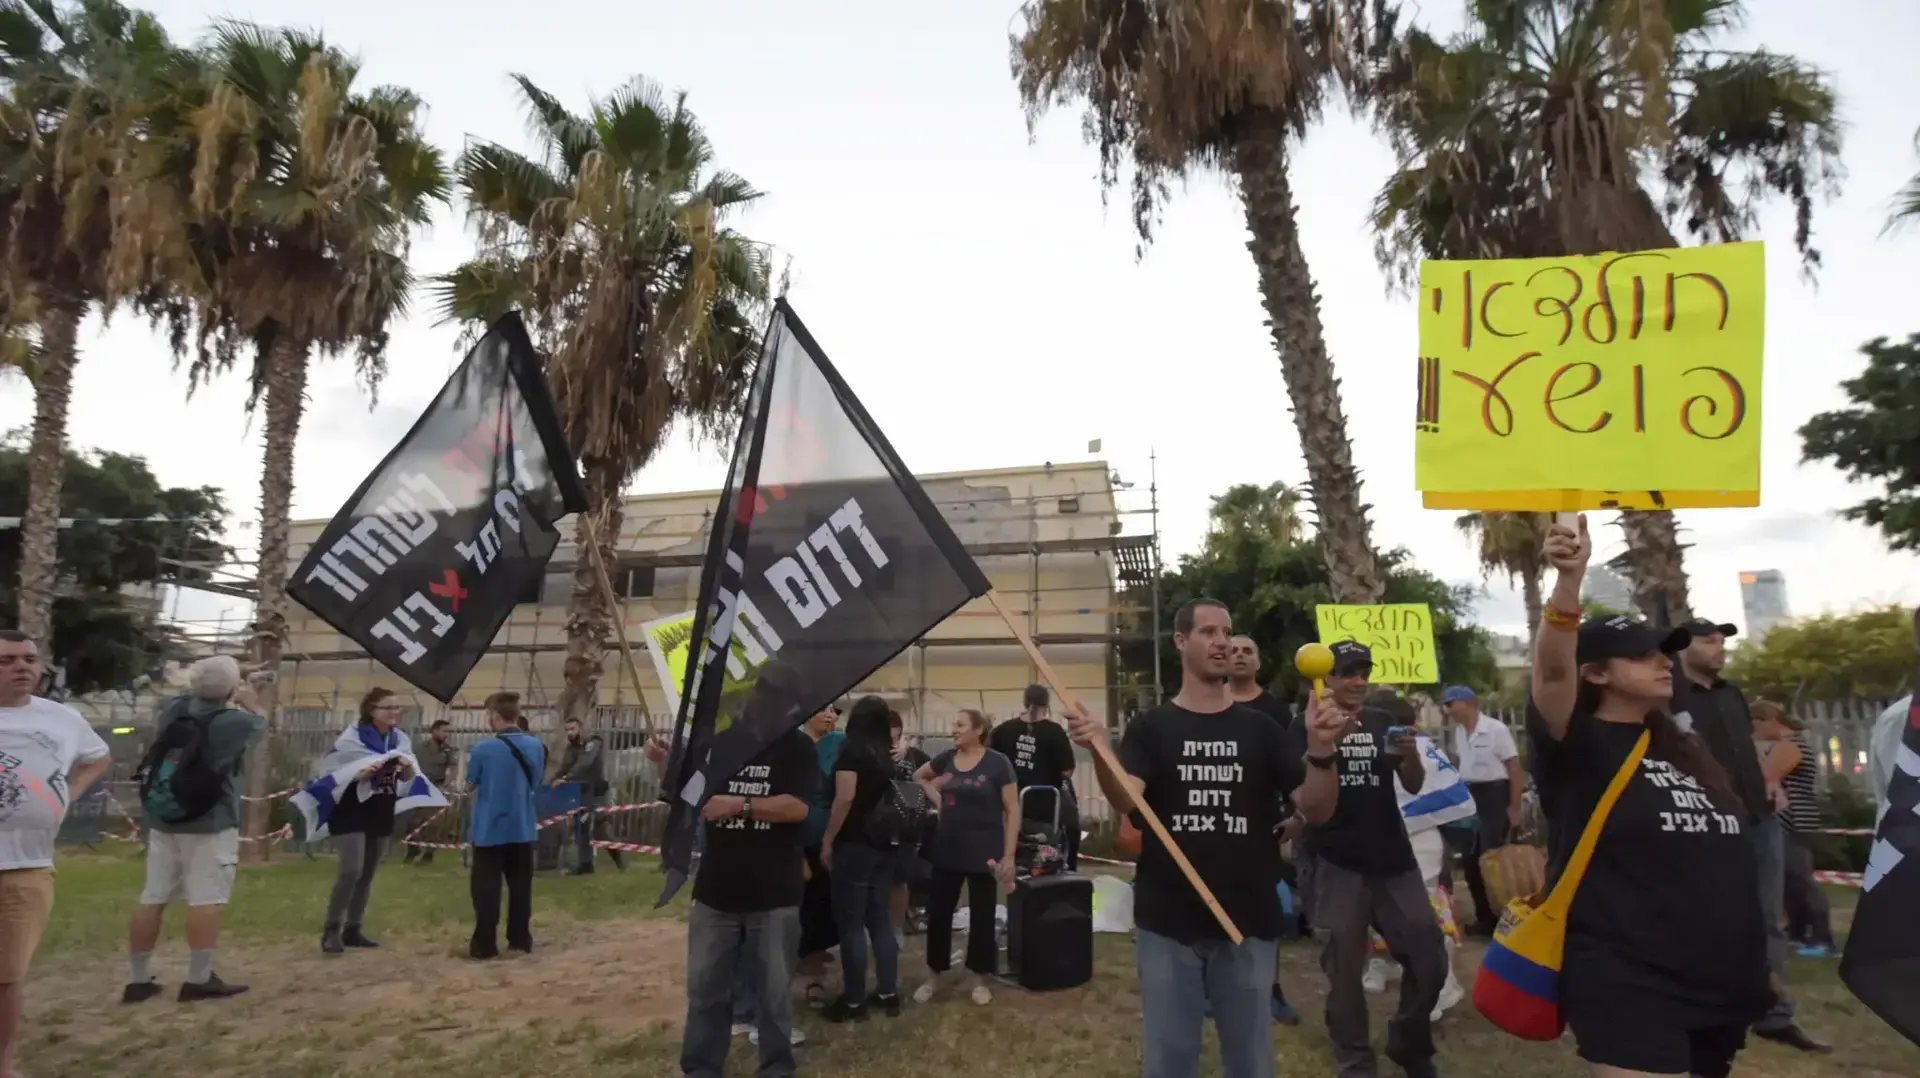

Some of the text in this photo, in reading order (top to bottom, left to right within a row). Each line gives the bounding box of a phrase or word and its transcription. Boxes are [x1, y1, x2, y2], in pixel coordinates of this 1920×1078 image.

[1431, 252, 1729, 352] חולדאי
[305, 472, 458, 602] לשחרור
[763, 497, 890, 629] דרום
[1324, 606, 1422, 632] חולדאי
[1182, 740, 1238, 757] החזית
[1339, 744, 1378, 758] לשחרור
[736, 764, 772, 779] החזי
[1176, 762, 1244, 783] לשחרור
[1347, 759, 1372, 772] דרום
[1188, 789, 1232, 808] דרום
[1670, 789, 1715, 809] דרום
[1172, 812, 1248, 835] תל אביב
[1659, 811, 1740, 835] תל אביב
